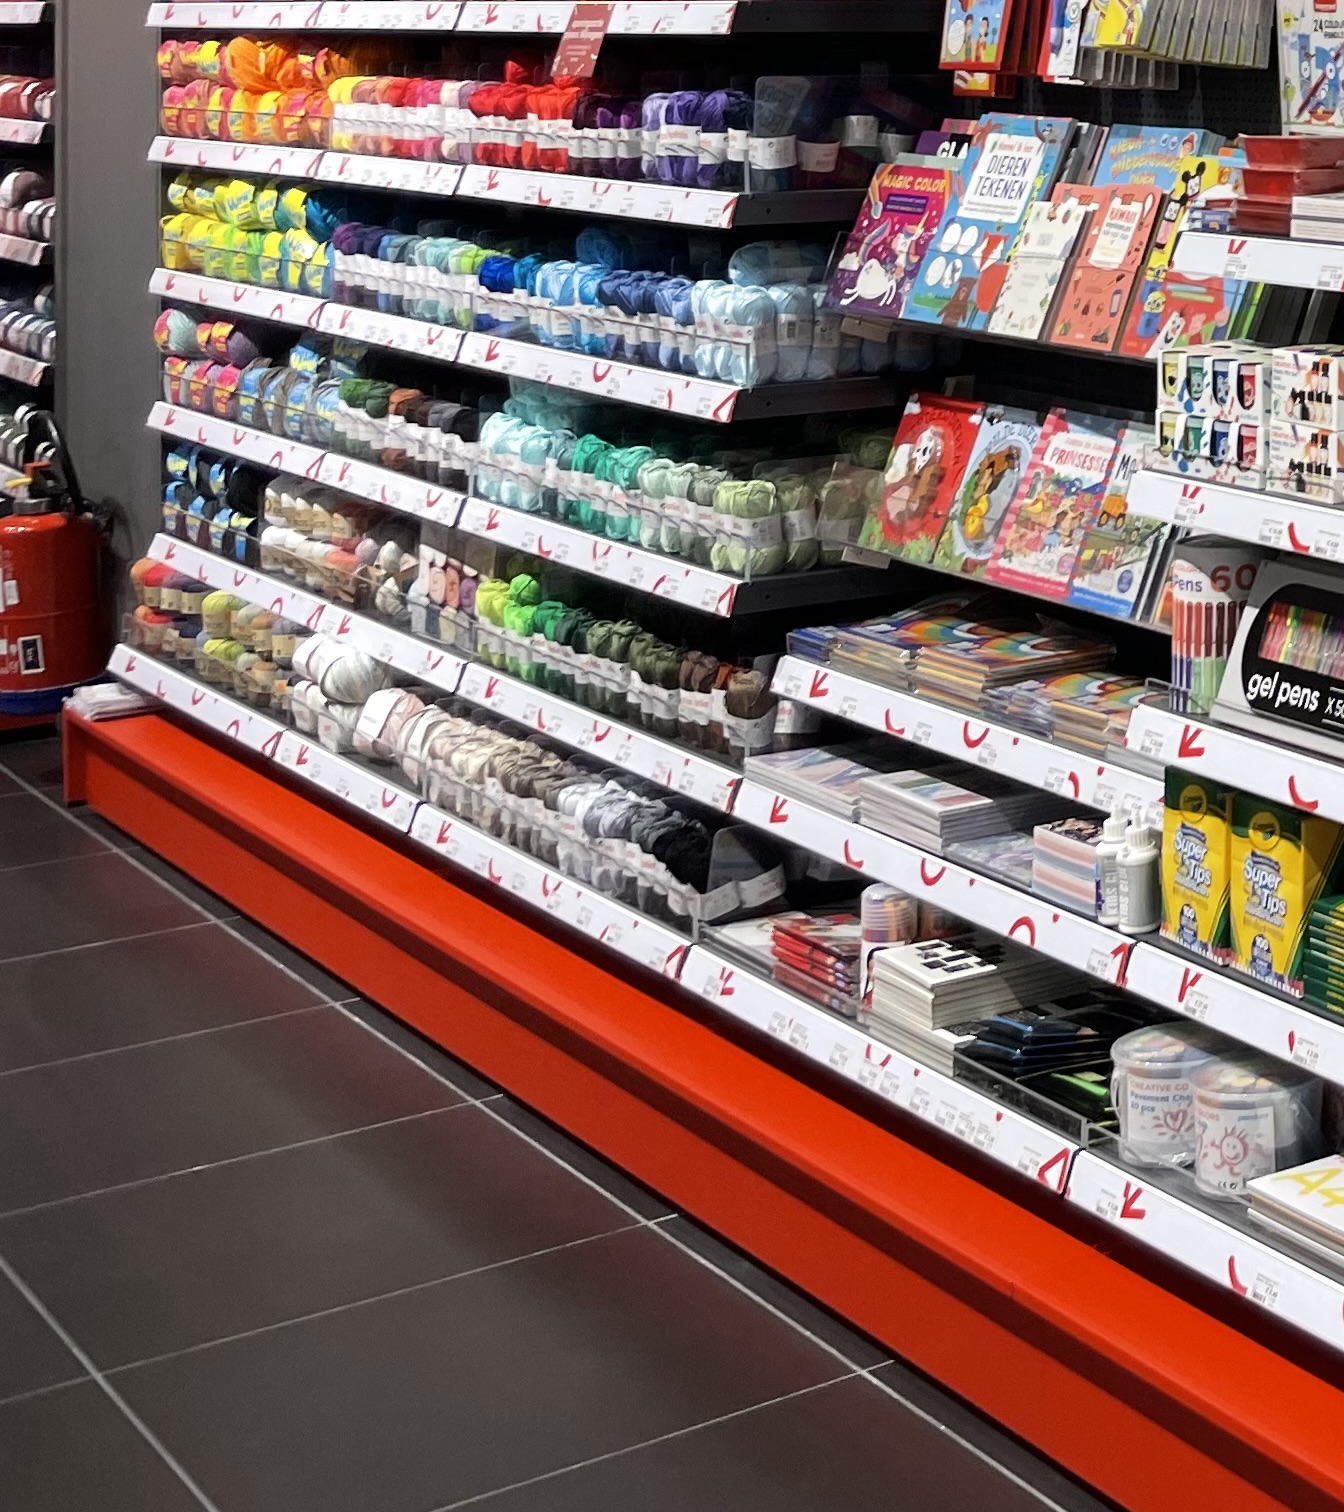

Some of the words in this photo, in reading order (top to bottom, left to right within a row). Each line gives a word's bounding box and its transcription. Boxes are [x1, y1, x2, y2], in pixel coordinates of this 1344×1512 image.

[1313, 18, 1323, 33] 24
[987, 155, 1031, 175] DIEREN
[882, 174, 913, 189] MAGIC
[914, 177, 947, 192] COLOR
[974, 176, 1025, 200] TEKENEN
[1246, 669, 1276, 704] gel
[1279, 682, 1320, 713] pens
[1173, 830, 1208, 863] Super
[1188, 856, 1212, 888] Tips
[1243, 858, 1281, 892] Super
[1261, 889, 1287, 916] Tips
